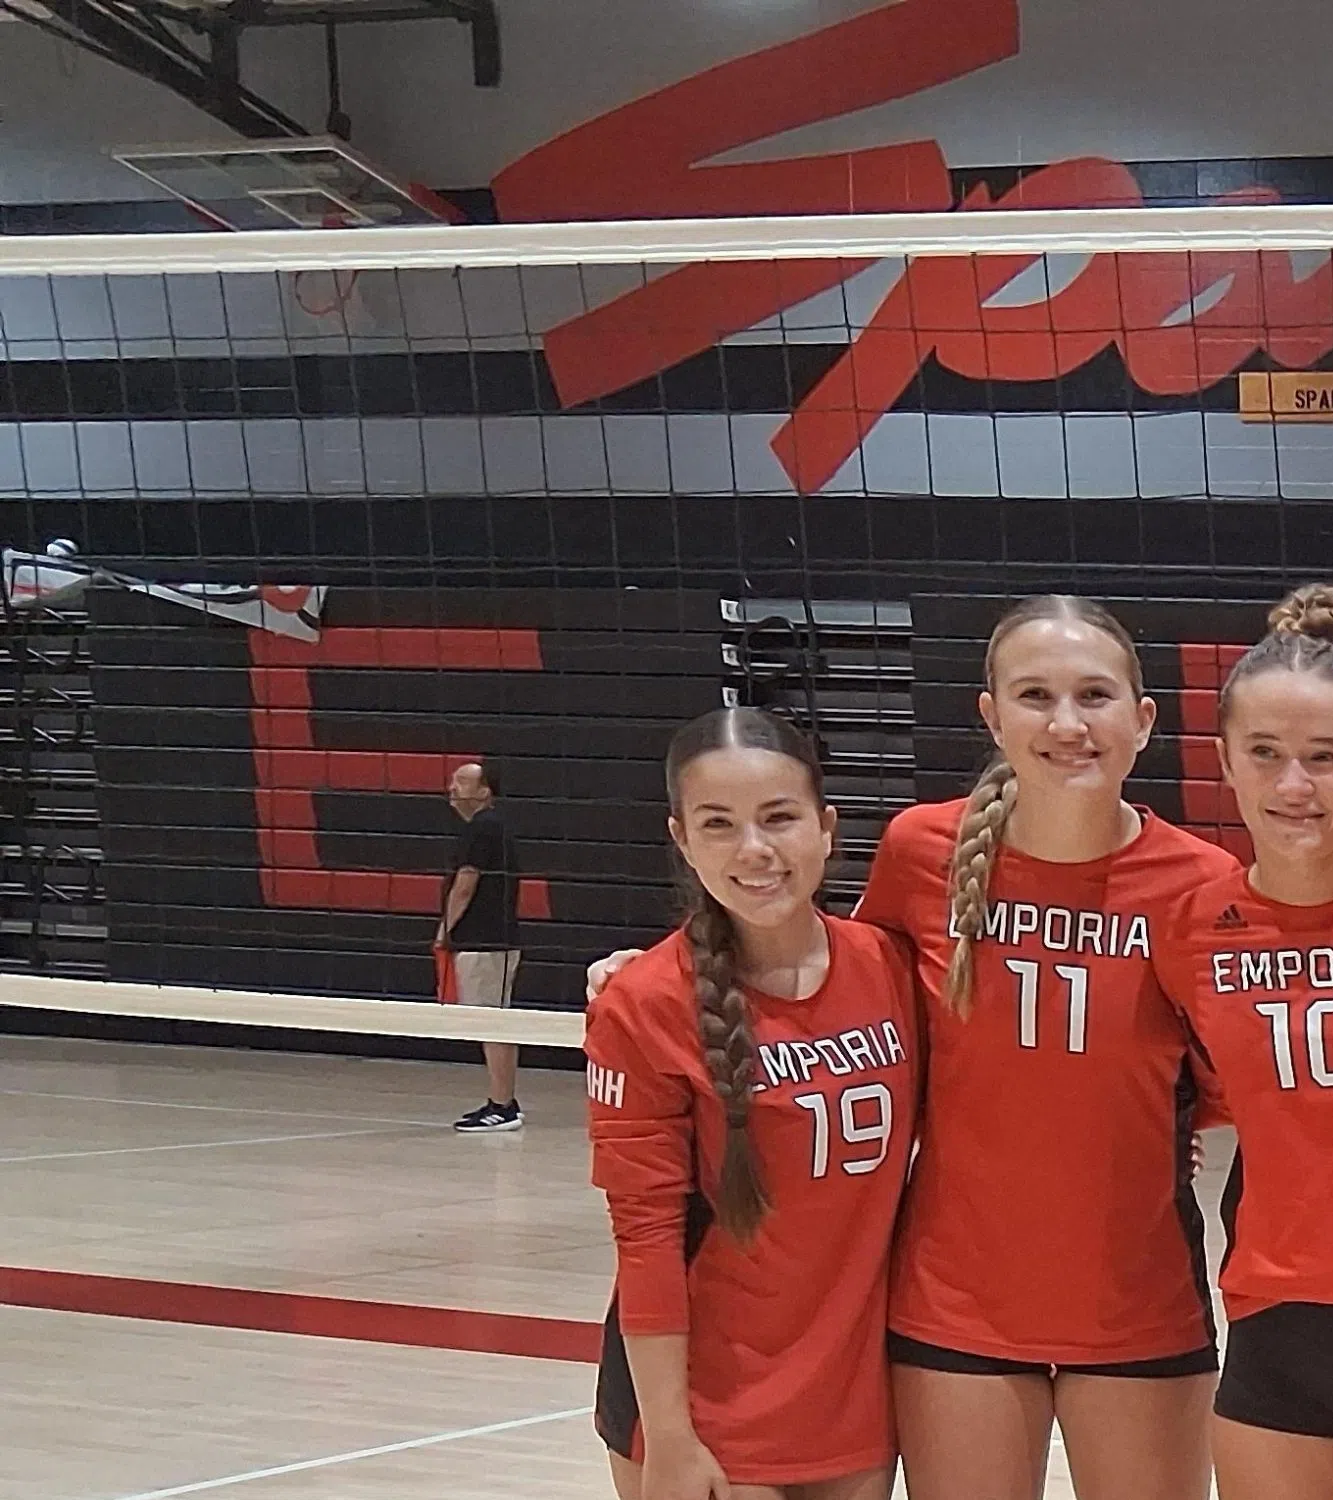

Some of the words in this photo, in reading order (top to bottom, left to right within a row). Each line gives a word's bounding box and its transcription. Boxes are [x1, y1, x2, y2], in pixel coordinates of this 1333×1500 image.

[1005, 959, 1088, 1053] 11
[752, 1020, 907, 1092] MPORIA
[794, 1083, 893, 1178] 19
